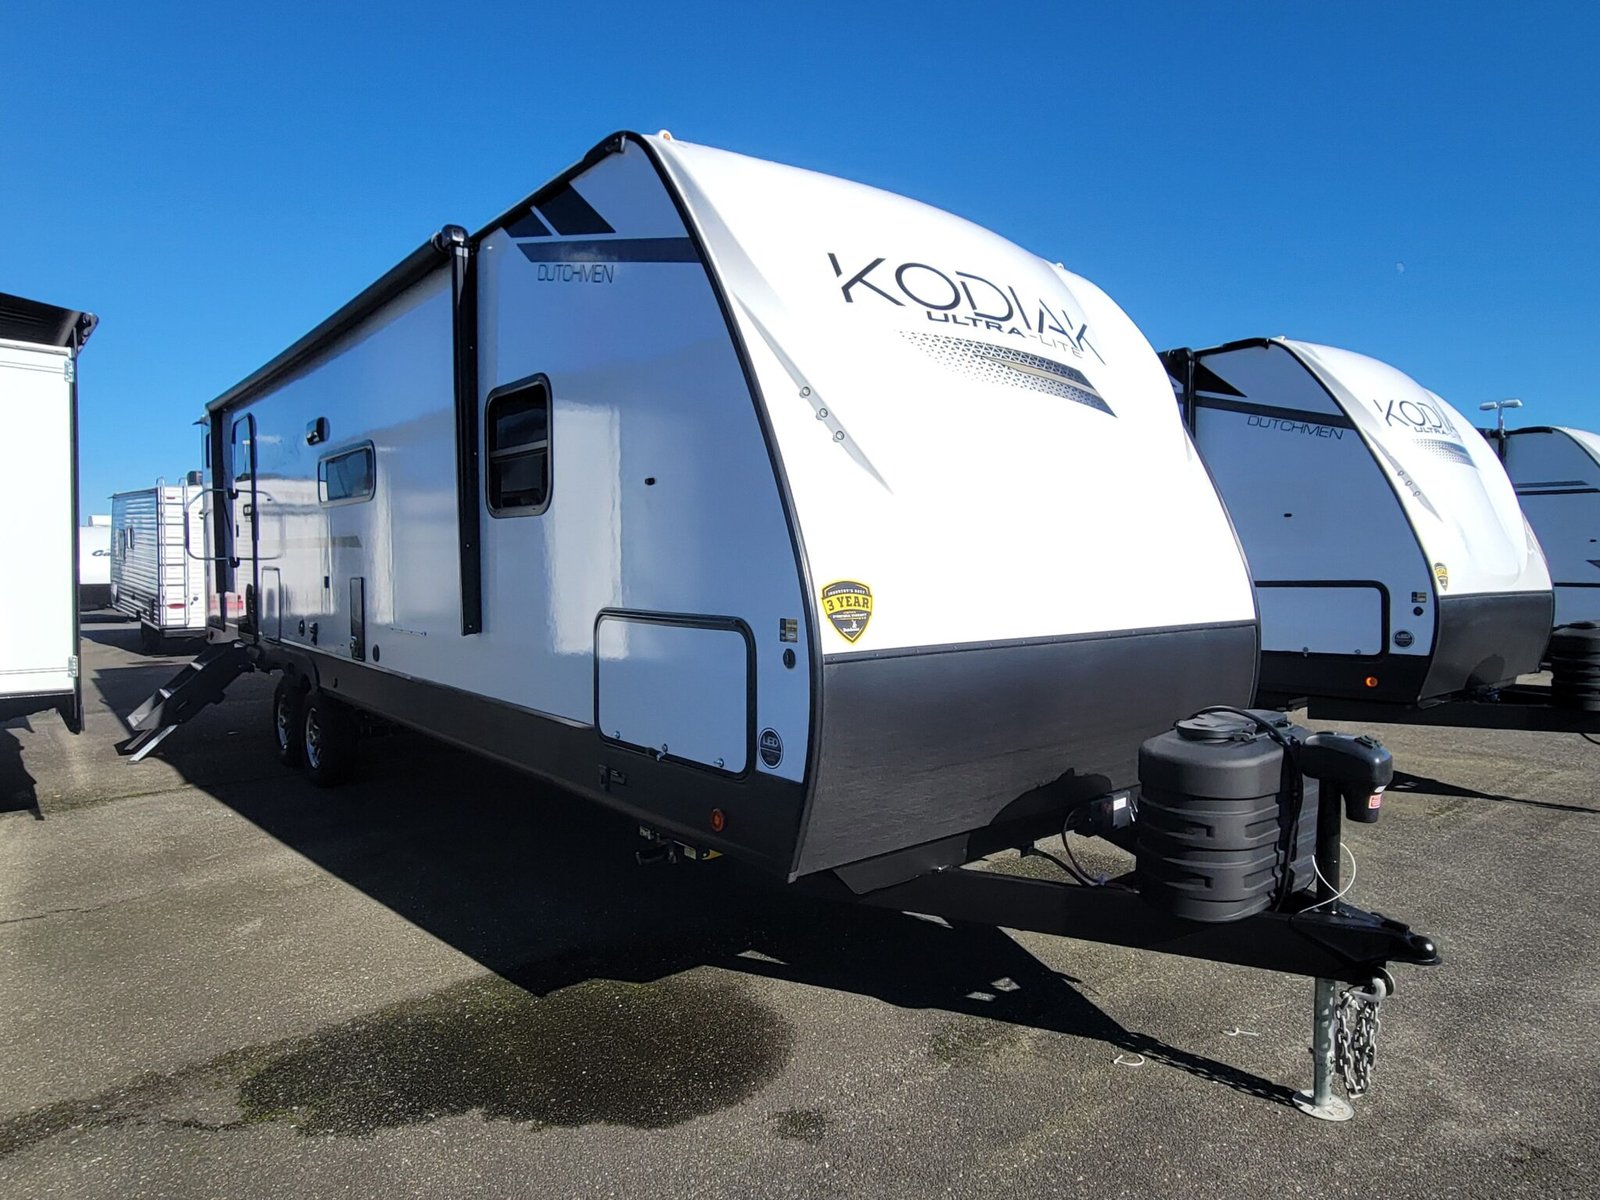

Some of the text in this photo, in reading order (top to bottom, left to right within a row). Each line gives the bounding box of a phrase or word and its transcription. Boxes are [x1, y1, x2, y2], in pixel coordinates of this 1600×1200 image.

[537, 264, 614, 283] DUTCHMEN
[827, 252, 1106, 365] KODIAK
[1247, 415, 1344, 440] DUTCHMEN
[826, 596, 869, 611] 3 YEAR
[763, 735, 778, 747] LED
